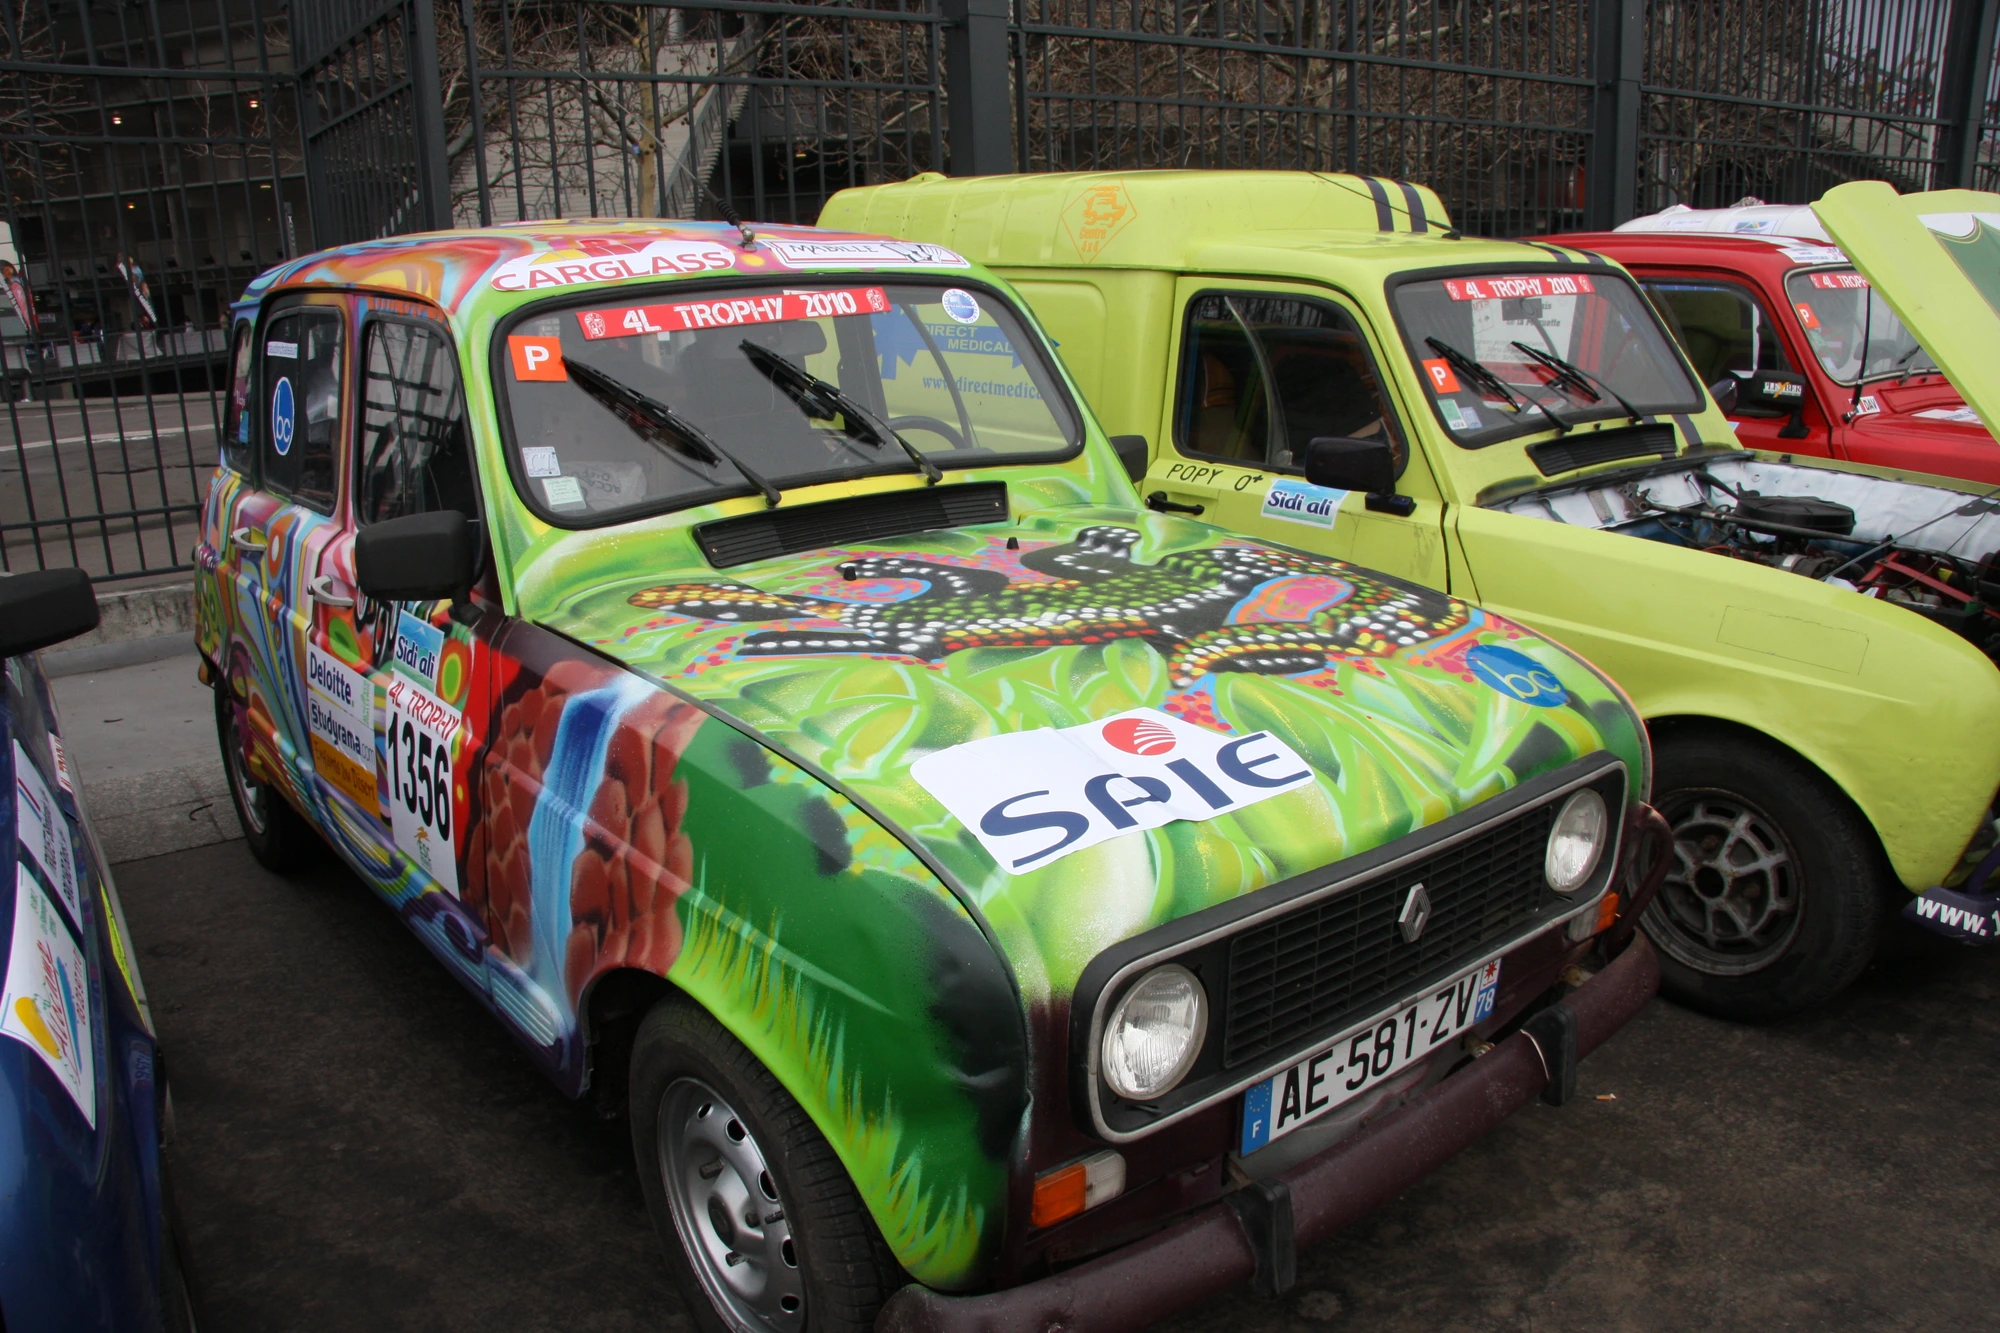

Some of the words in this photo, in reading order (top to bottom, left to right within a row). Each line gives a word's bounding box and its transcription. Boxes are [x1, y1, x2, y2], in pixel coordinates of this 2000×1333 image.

[491, 251, 734, 291] CARGLASS
[1822, 275, 1838, 288] 4L
[1837, 275, 1867, 289] TROPH
[1465, 282, 1487, 299] 4L
[1488, 278, 1543, 298] TROPHY
[1546, 277, 1578, 294] 2010
[622, 309, 663, 333] 4L
[674, 297, 783, 328] TROPHY
[799, 291, 858, 318] 2010
[1799, 307, 1810, 323] P
[524, 345, 550, 371] P
[948, 338, 1014, 354] MEDICAL
[1431, 366, 1447, 386] P
[1166, 463, 1224, 485] POPY
[1267, 490, 1303, 512] Sidi
[1306, 498, 1334, 517] ali
[395, 635, 419, 671] Sidi
[418, 650, 436, 680] ali
[389, 680, 405, 710] 4L
[406, 689, 461, 741] TROPHY
[388, 711, 451, 842] 1356
[1476, 988, 1496, 1018] 78
[1252, 1119, 1263, 1139] F
